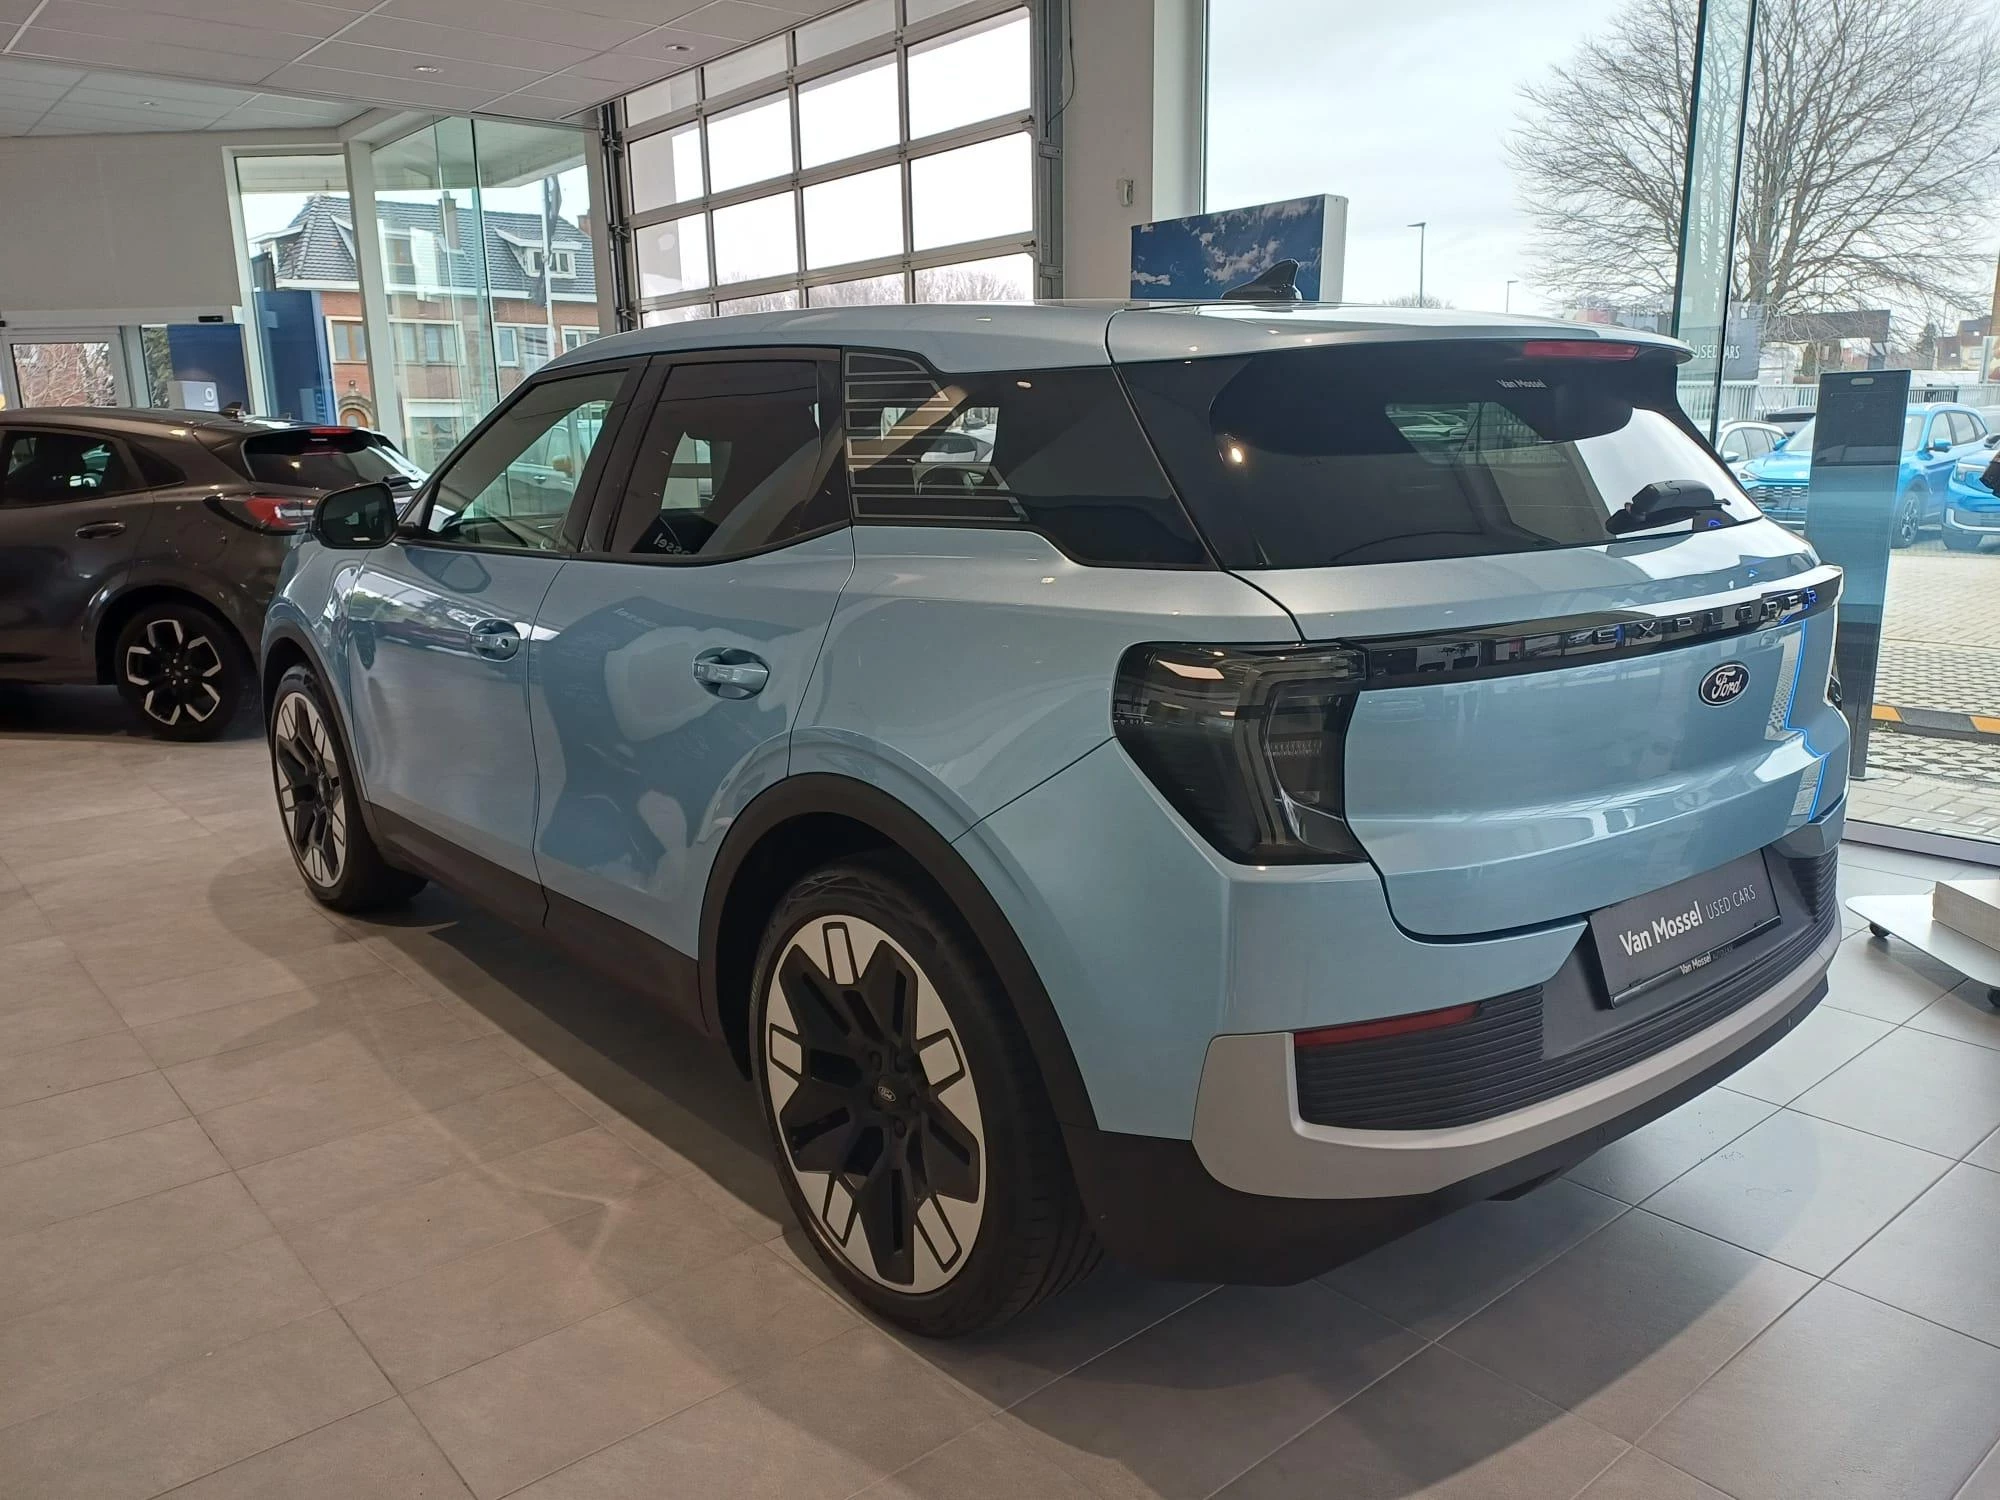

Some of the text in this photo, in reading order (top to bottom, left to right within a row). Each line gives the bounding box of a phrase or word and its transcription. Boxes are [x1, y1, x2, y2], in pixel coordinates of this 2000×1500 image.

[1594, 587, 1817, 645] EXPLORER
[1619, 884, 1756, 957] Van Mossel USED CARS
[1680, 963, 1693, 975] Van
[1691, 952, 1712, 970] Mossel
